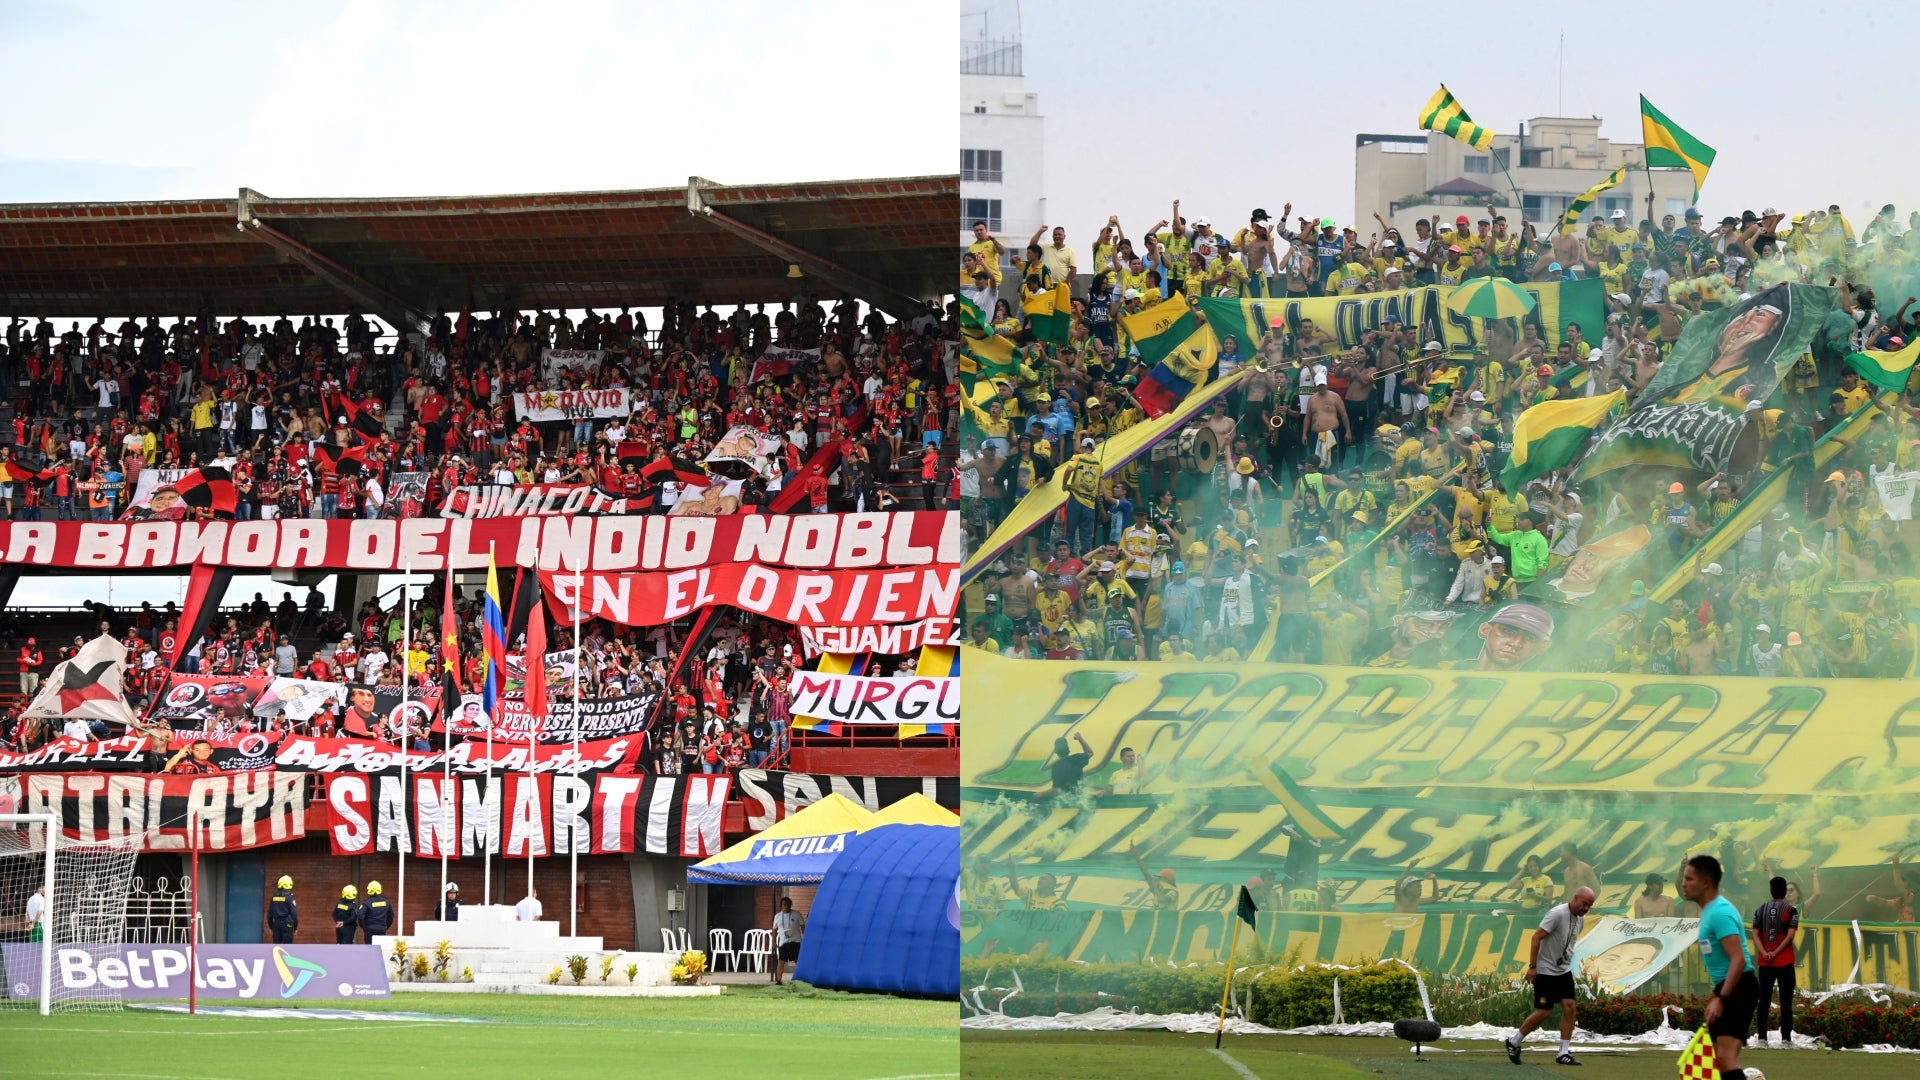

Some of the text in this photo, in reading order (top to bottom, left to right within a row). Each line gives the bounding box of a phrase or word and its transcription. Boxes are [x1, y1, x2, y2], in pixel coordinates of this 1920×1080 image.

[515, 513, 718, 572] INDIO
[1612, 920, 1657, 936] Miguel
[57, 946, 266, 999] BetPlay
